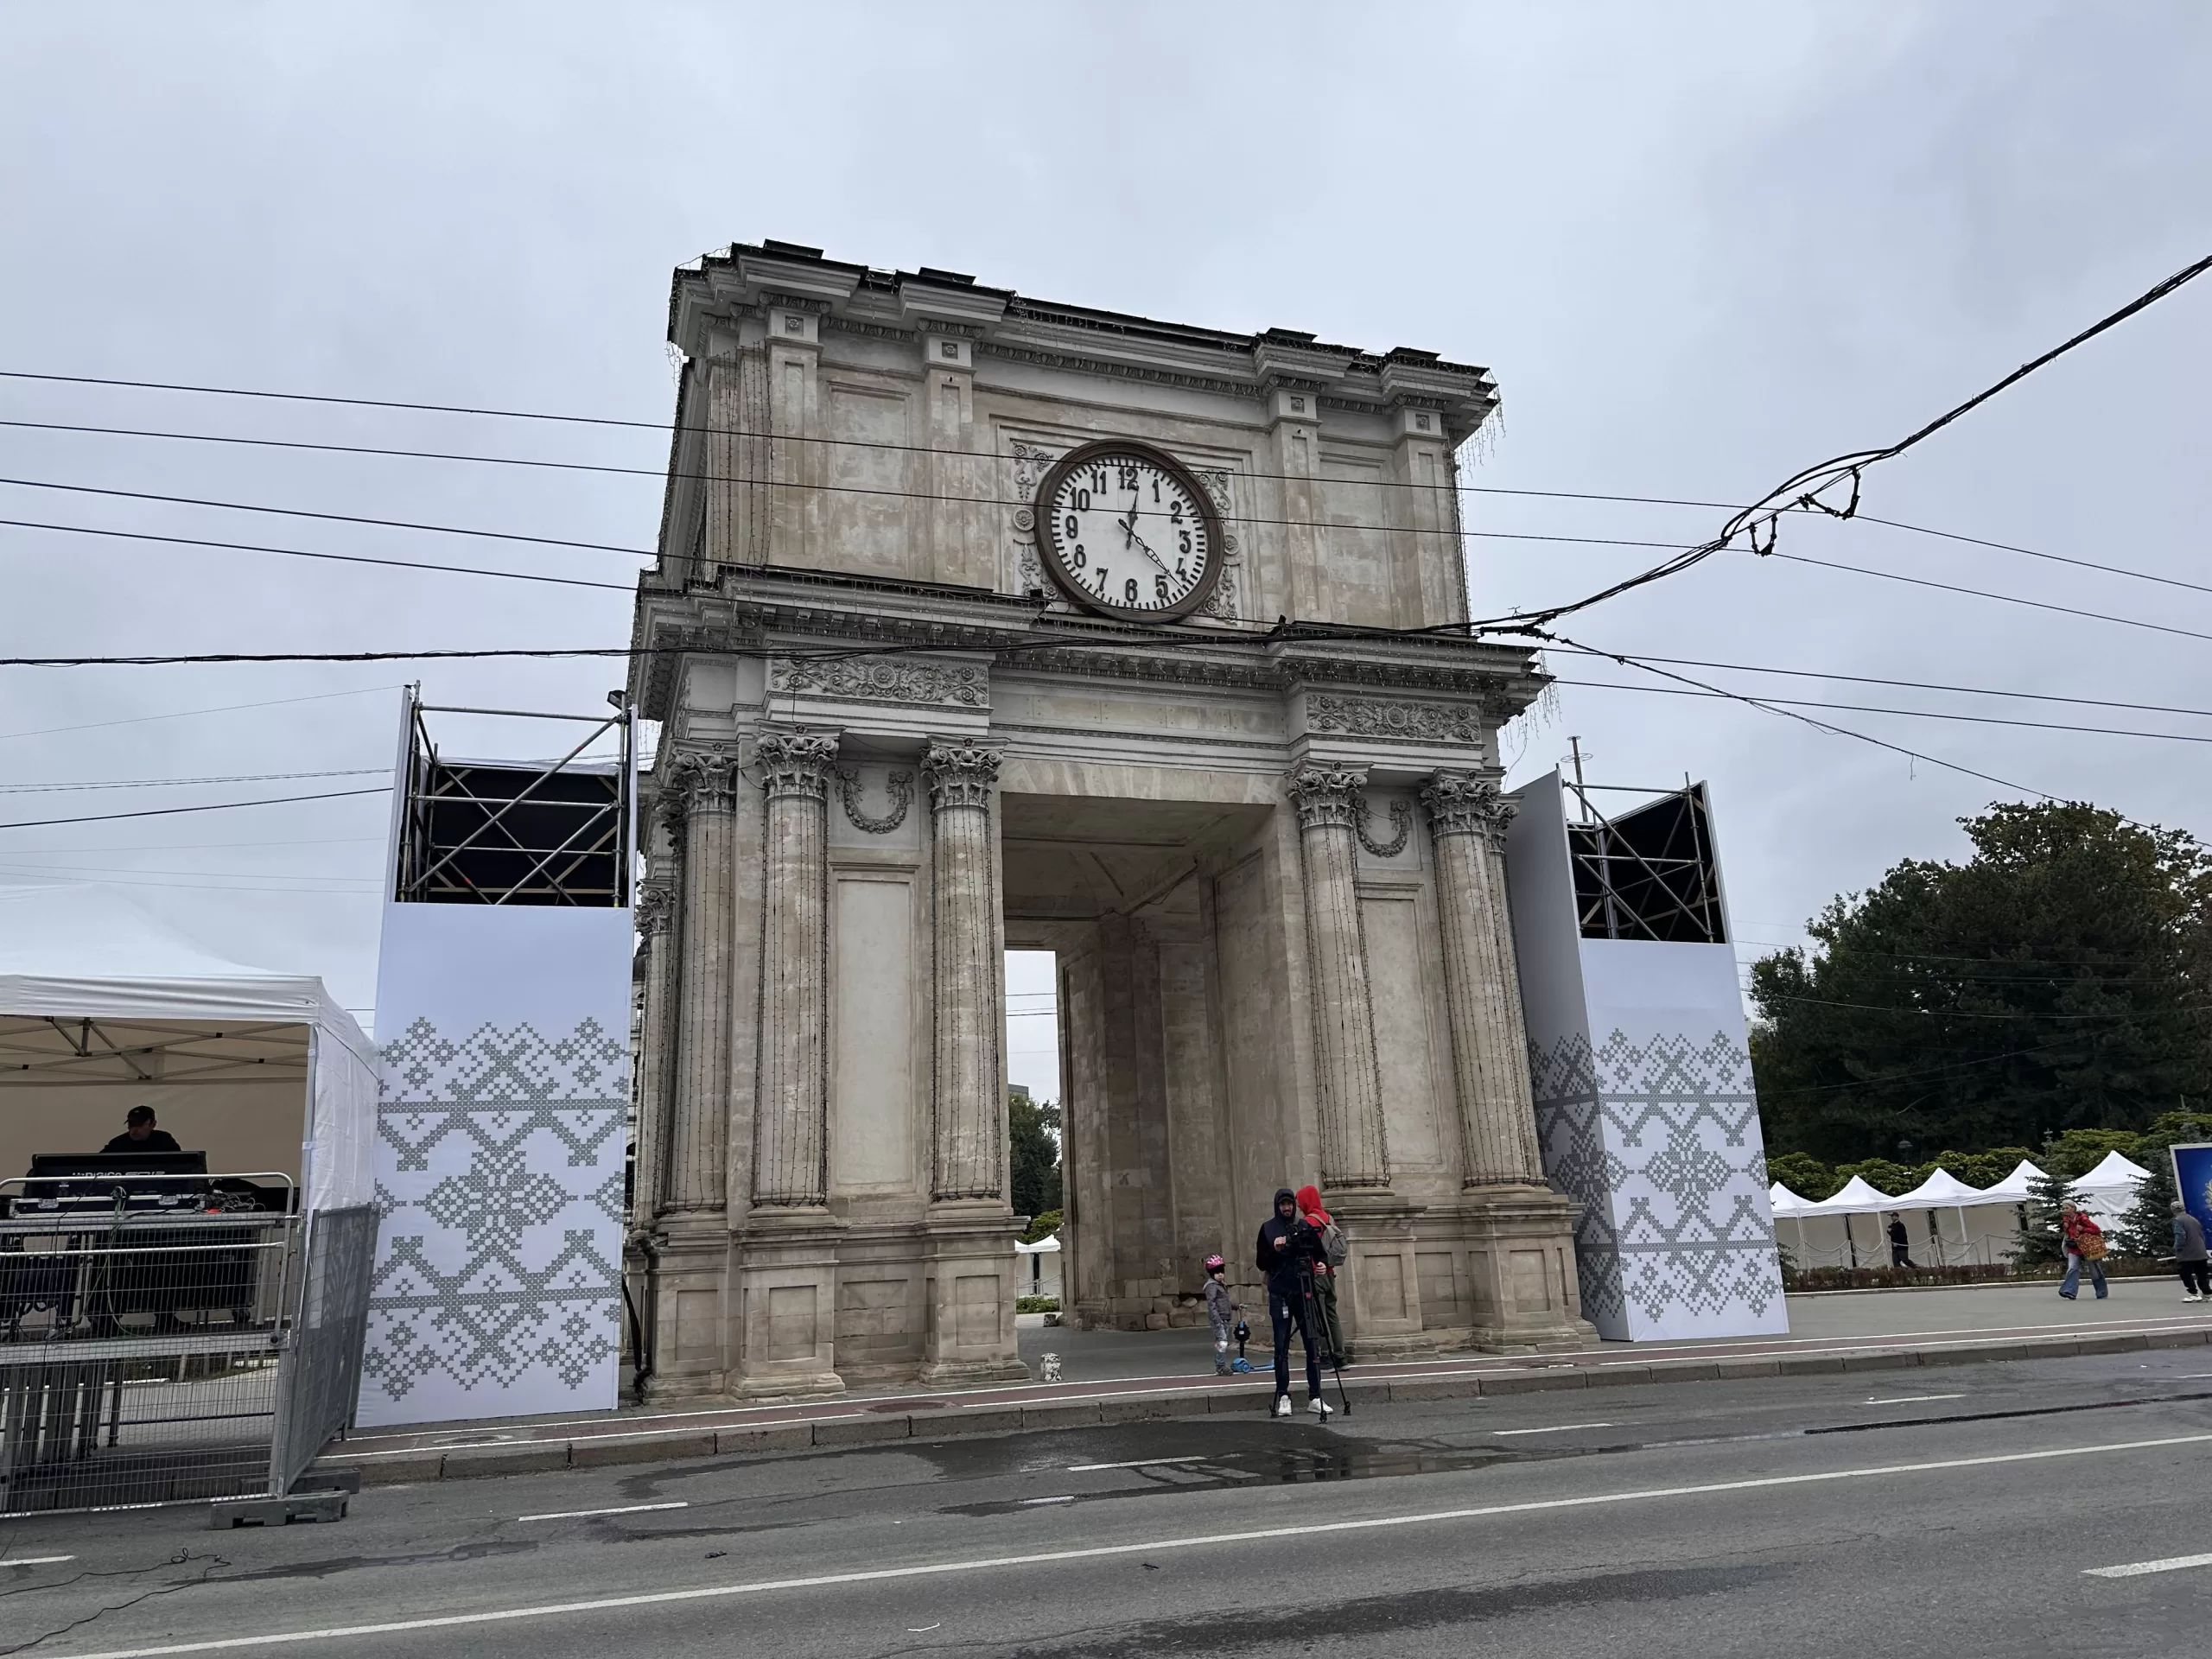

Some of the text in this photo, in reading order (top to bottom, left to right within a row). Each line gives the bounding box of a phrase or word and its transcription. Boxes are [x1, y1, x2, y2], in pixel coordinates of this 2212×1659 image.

[1091, 469, 1107, 494] 11
[1118, 466, 1140, 490] 12
[1070, 487, 1090, 512] 10
[1153, 480, 1160, 502] 1
[1170, 500, 1183, 524] 2
[1065, 515, 1078, 538] 9
[1179, 530, 1192, 553] 3
[1073, 544, 1086, 568] 8
[1096, 568, 1108, 591] 7
[1175, 557, 1187, 581] 4
[1125, 578, 1138, 601] 6
[1155, 575, 1168, 598] 5
